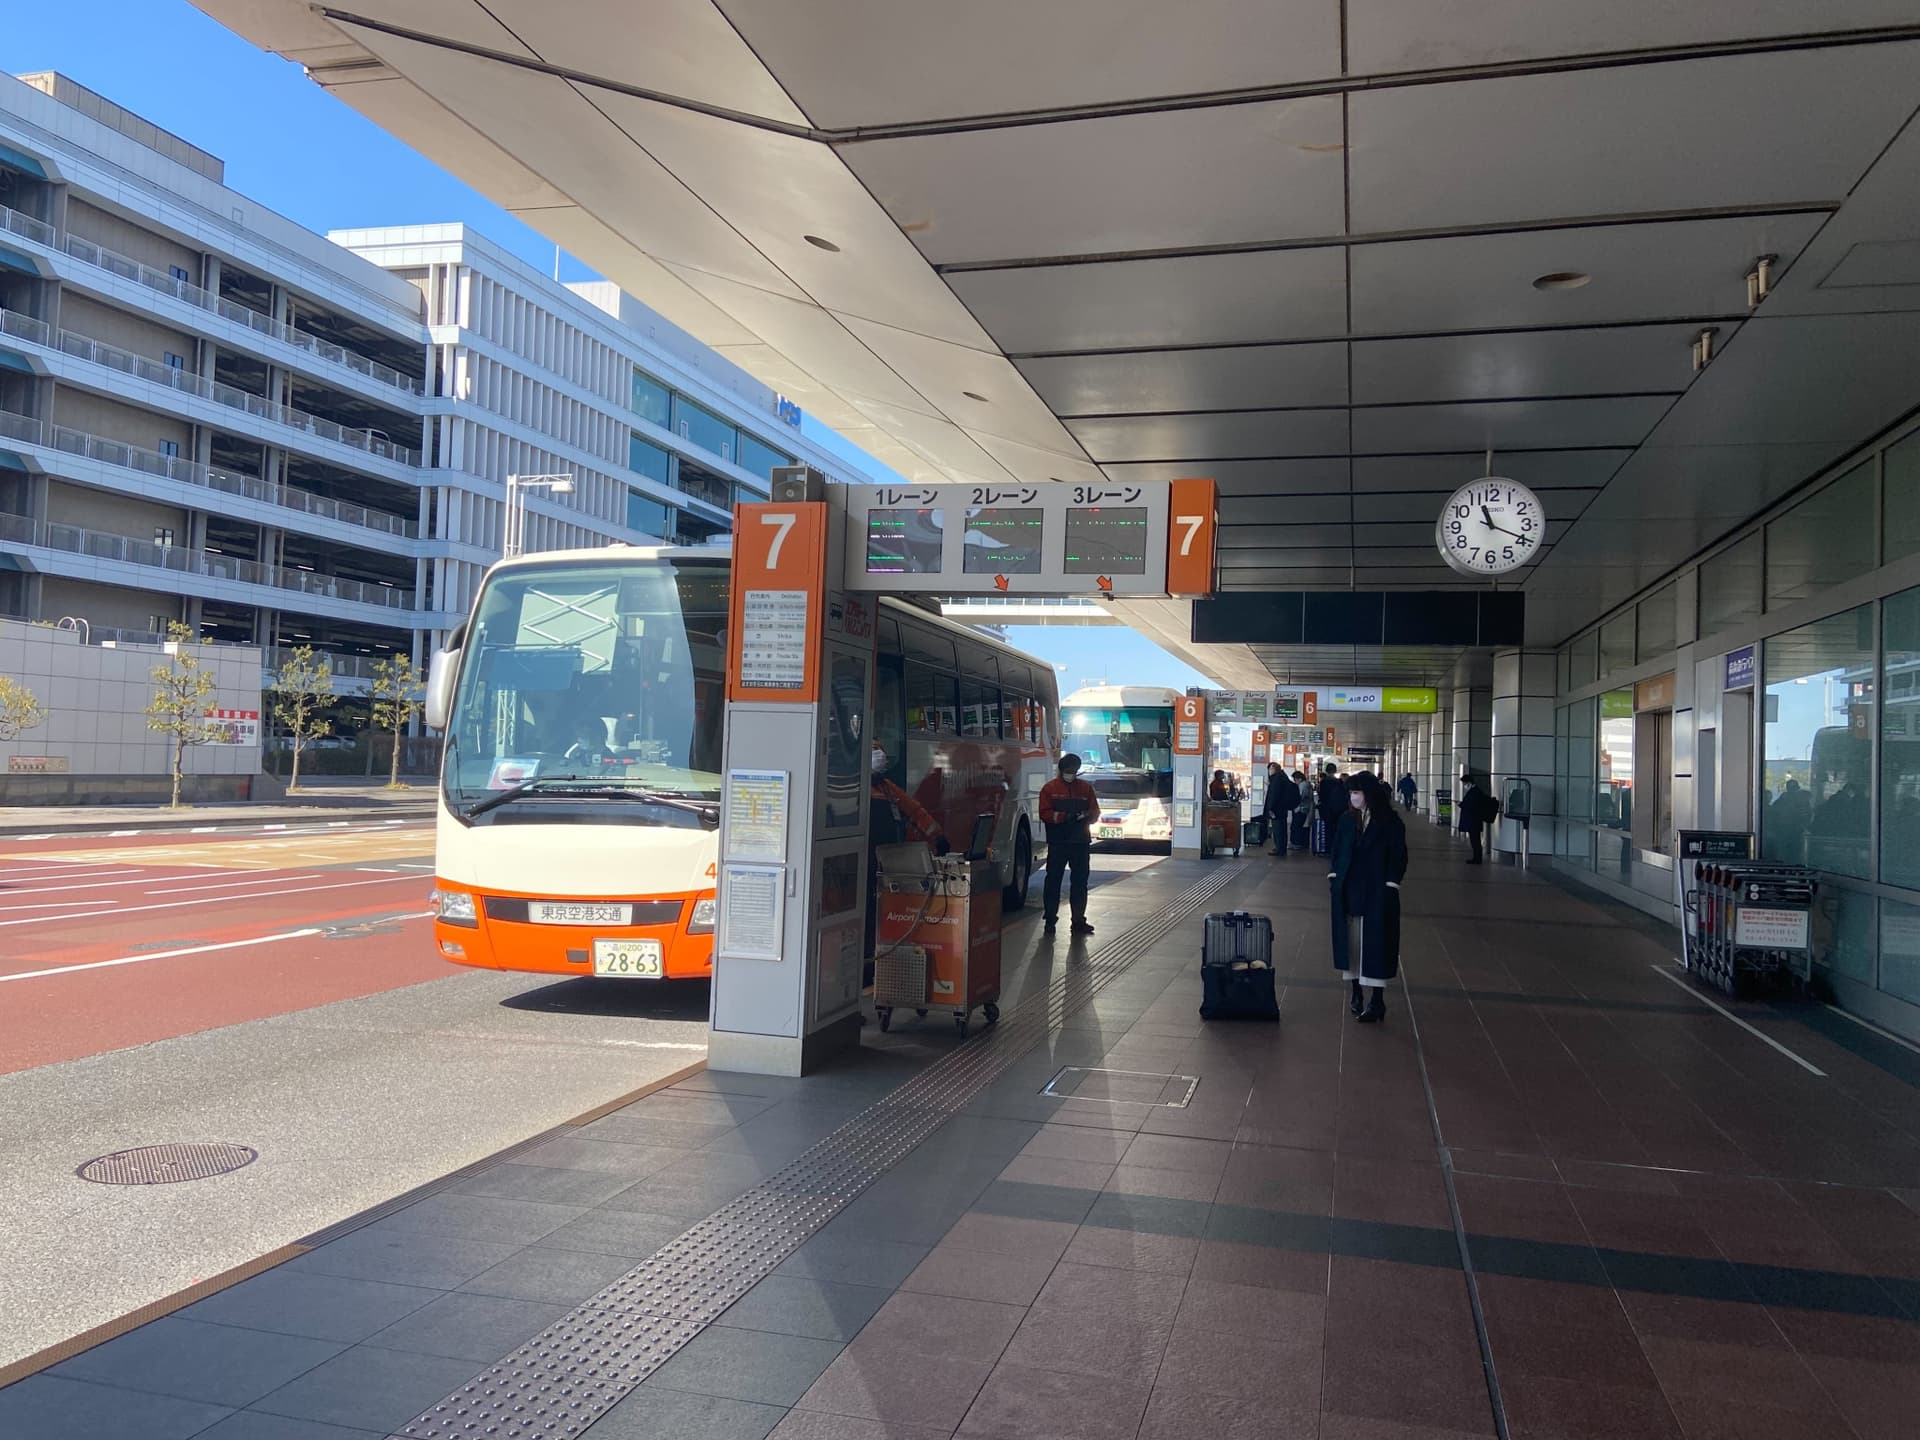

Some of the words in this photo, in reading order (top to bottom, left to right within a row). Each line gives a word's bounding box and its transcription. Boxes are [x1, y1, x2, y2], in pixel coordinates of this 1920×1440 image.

[876, 489, 938, 505] 1レーン
[972, 488, 1037, 504] 2レーン
[1073, 487, 1142, 504] 3レーン
[1470, 492, 1481, 505] 11
[1485, 489, 1500, 502] 12
[1507, 491, 1511, 504] 1
[1456, 505, 1470, 518] 10
[1516, 502, 1527, 515] 2
[1451, 521, 1461, 534] 9
[1521, 518, 1532, 531] 3
[761, 513, 796, 570] 7
[1176, 515, 1204, 556] 7
[1457, 535, 1467, 548] 8
[1515, 534, 1526, 546] 4
[1470, 548, 1480, 560] 7
[1485, 551, 1496, 564] 6
[1502, 546, 1513, 559] 5
[1184, 700, 1196, 717] 6
[1306, 702, 1314, 714] 6
[1256, 731, 1264, 742] 5
[541, 905, 622, 921] 東京空港交通
[887, 912, 914, 922] Airport
